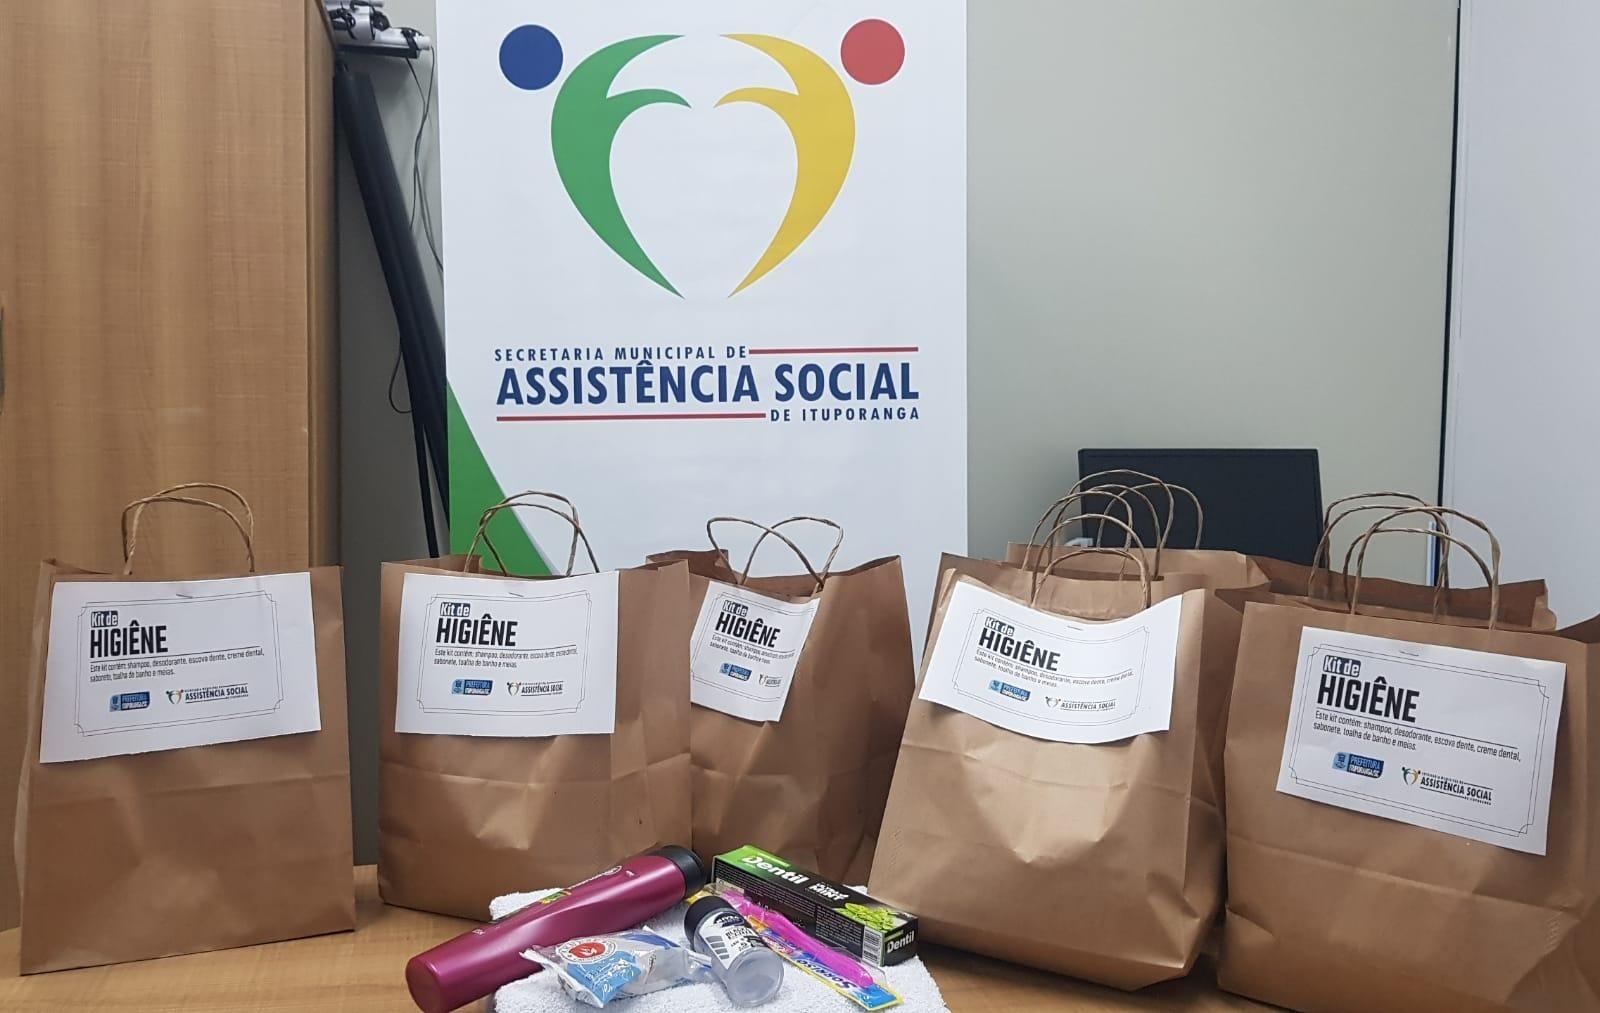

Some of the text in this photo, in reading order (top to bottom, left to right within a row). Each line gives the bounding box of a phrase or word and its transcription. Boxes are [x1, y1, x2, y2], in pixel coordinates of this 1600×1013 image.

[495, 346, 746, 361] SECRETARIA MUNICIPAL DE
[496, 360, 919, 405] ASSISTÊNCIA SOCIAL
[770, 407, 919, 421] DE ITUPORANGA
[441, 602, 469, 617] Kit de
[723, 600, 734, 613] Kit
[92, 611, 118, 627] Kit de
[436, 614, 518, 646] HIGIÊNE
[715, 612, 780, 648] HIGIÊNE
[985, 617, 1014, 636] Kit de
[90, 620, 168, 658] HIGIÊNE
[979, 628, 1061, 671] HIGIÊNE
[1323, 656, 1360, 676] Kit de
[185, 688, 225, 700] ASSISTÊNCIA
[227, 685, 248, 696] SOCIAL
[1317, 674, 1420, 723] HIGIÊNE
[1313, 722, 1341, 735] sabonete,
[1343, 728, 1362, 739] toalha
[1363, 731, 1371, 740] de
[1372, 733, 1391, 745] banho
[1397, 740, 1417, 750] meias.
[1315, 710, 1328, 720] Este
[1339, 716, 1362, 728] contém:
[1364, 721, 1393, 735] shampoo,
[1394, 727, 1432, 743] desodorante,
[1434, 736, 1455, 747] escova
[1456, 740, 1475, 752] dente,
[1477, 745, 1497, 756] creme
[1499, 748, 1521, 762] dental,
[1350, 755, 1381, 769] PREFEITURA
[1420, 776, 1465, 794] ASSISTÊNCIA
[1466, 786, 1492, 801] SOCIAL
[742, 856, 810, 884] Dentil
[808, 884, 849, 901] MINT
[887, 930, 915, 954] Dentil
